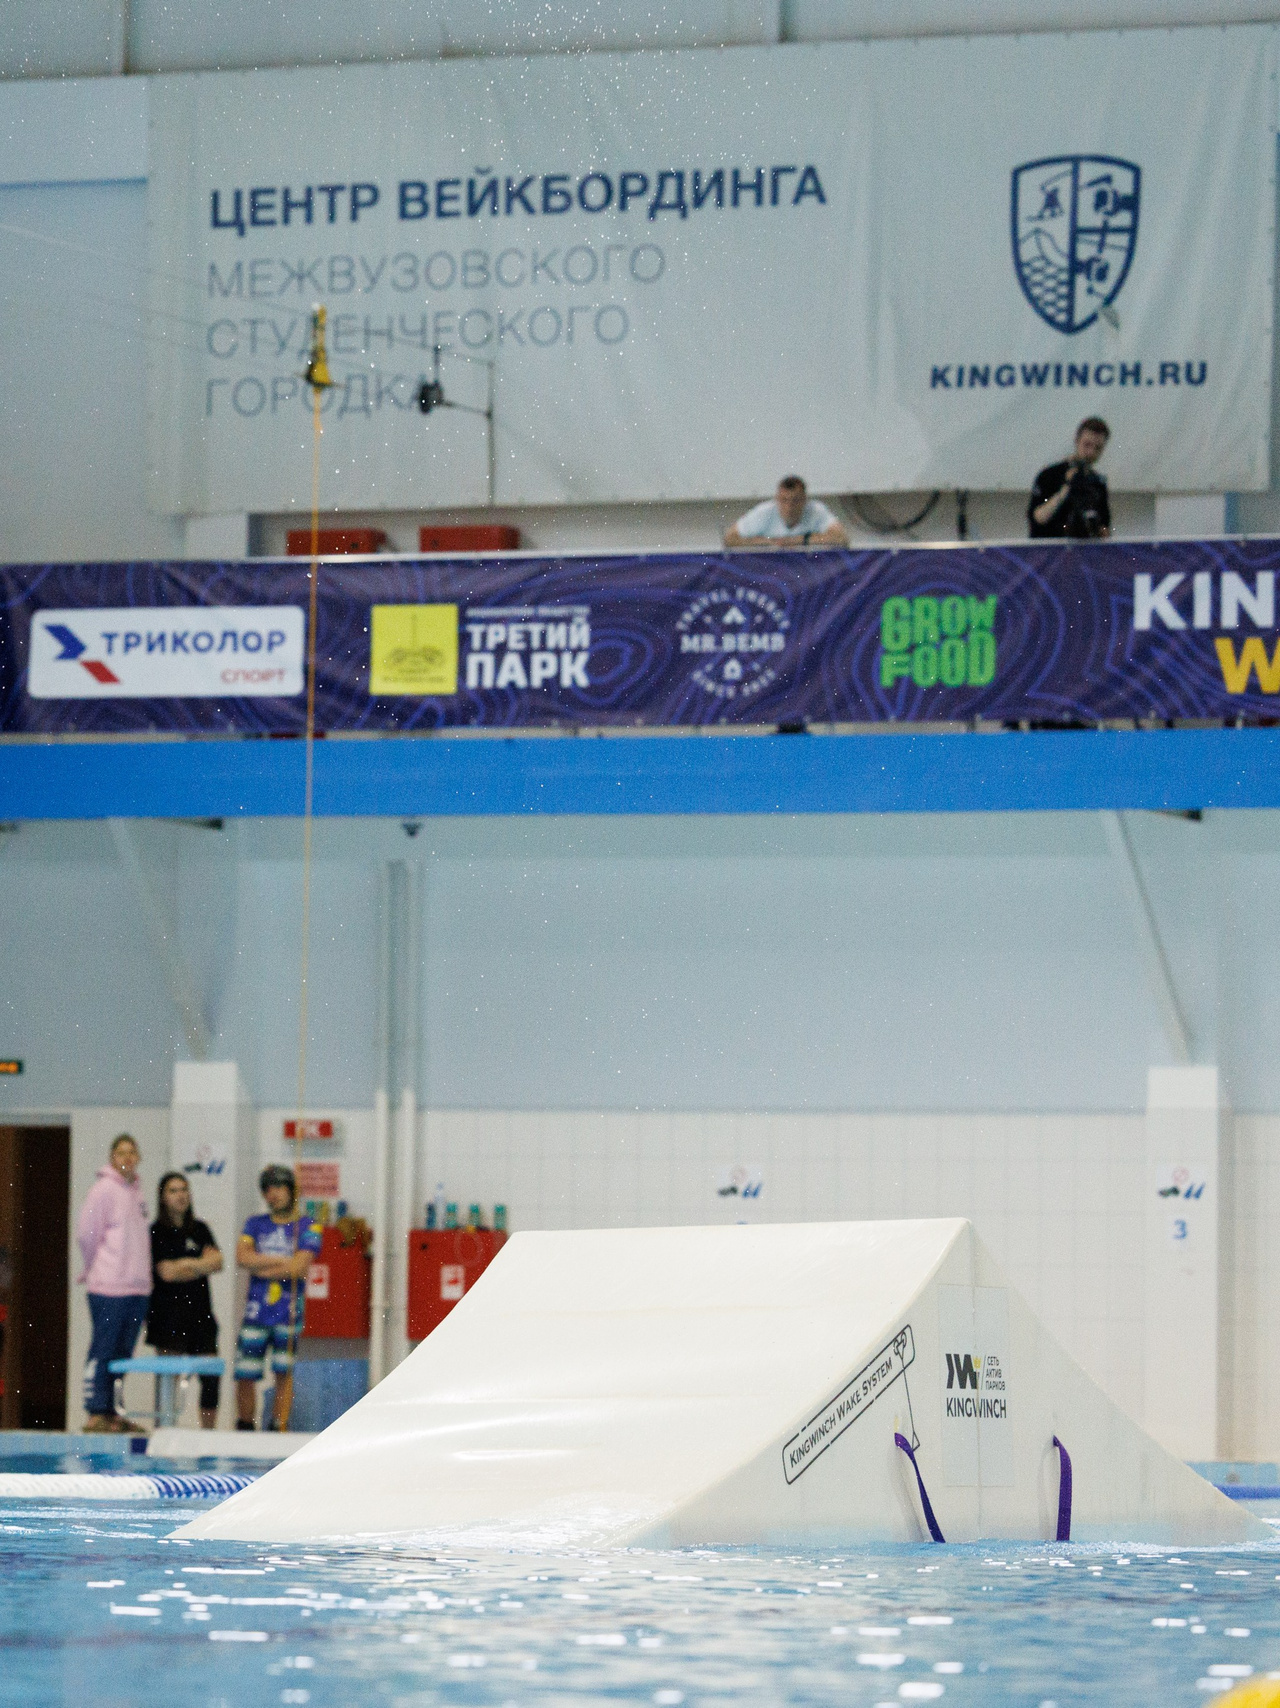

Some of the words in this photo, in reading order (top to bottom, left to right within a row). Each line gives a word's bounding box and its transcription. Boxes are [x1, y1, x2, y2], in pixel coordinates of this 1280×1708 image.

[210, 184, 380, 237] ЦЕНТР
[399, 164, 827, 221] ВЕЙКБОРДИНГА
[207, 244, 666, 299] МЕЖВУЗОВСКОГО
[930, 361, 1208, 389] KINGWINCH.RU
[467, 616, 591, 650] ТРЕТИЙ
[881, 594, 998, 653] GROW
[100, 630, 286, 656] ТРИКОЛОР
[466, 651, 590, 689] ПАРК
[880, 631, 997, 688] FOOD
[220, 668, 286, 684] СПОРТ
[986, 1368, 1003, 1379] АКТИВ
[987, 1356, 1000, 1366] СЕТЬ
[985, 1380, 1006, 1391] ПАРКОВ
[789, 1413, 836, 1468] KINGWINCH
[836, 1390, 862, 1420] WAKE
[861, 1357, 893, 1396] SYSTEM
[946, 1397, 1007, 1418] KINGWINCH
